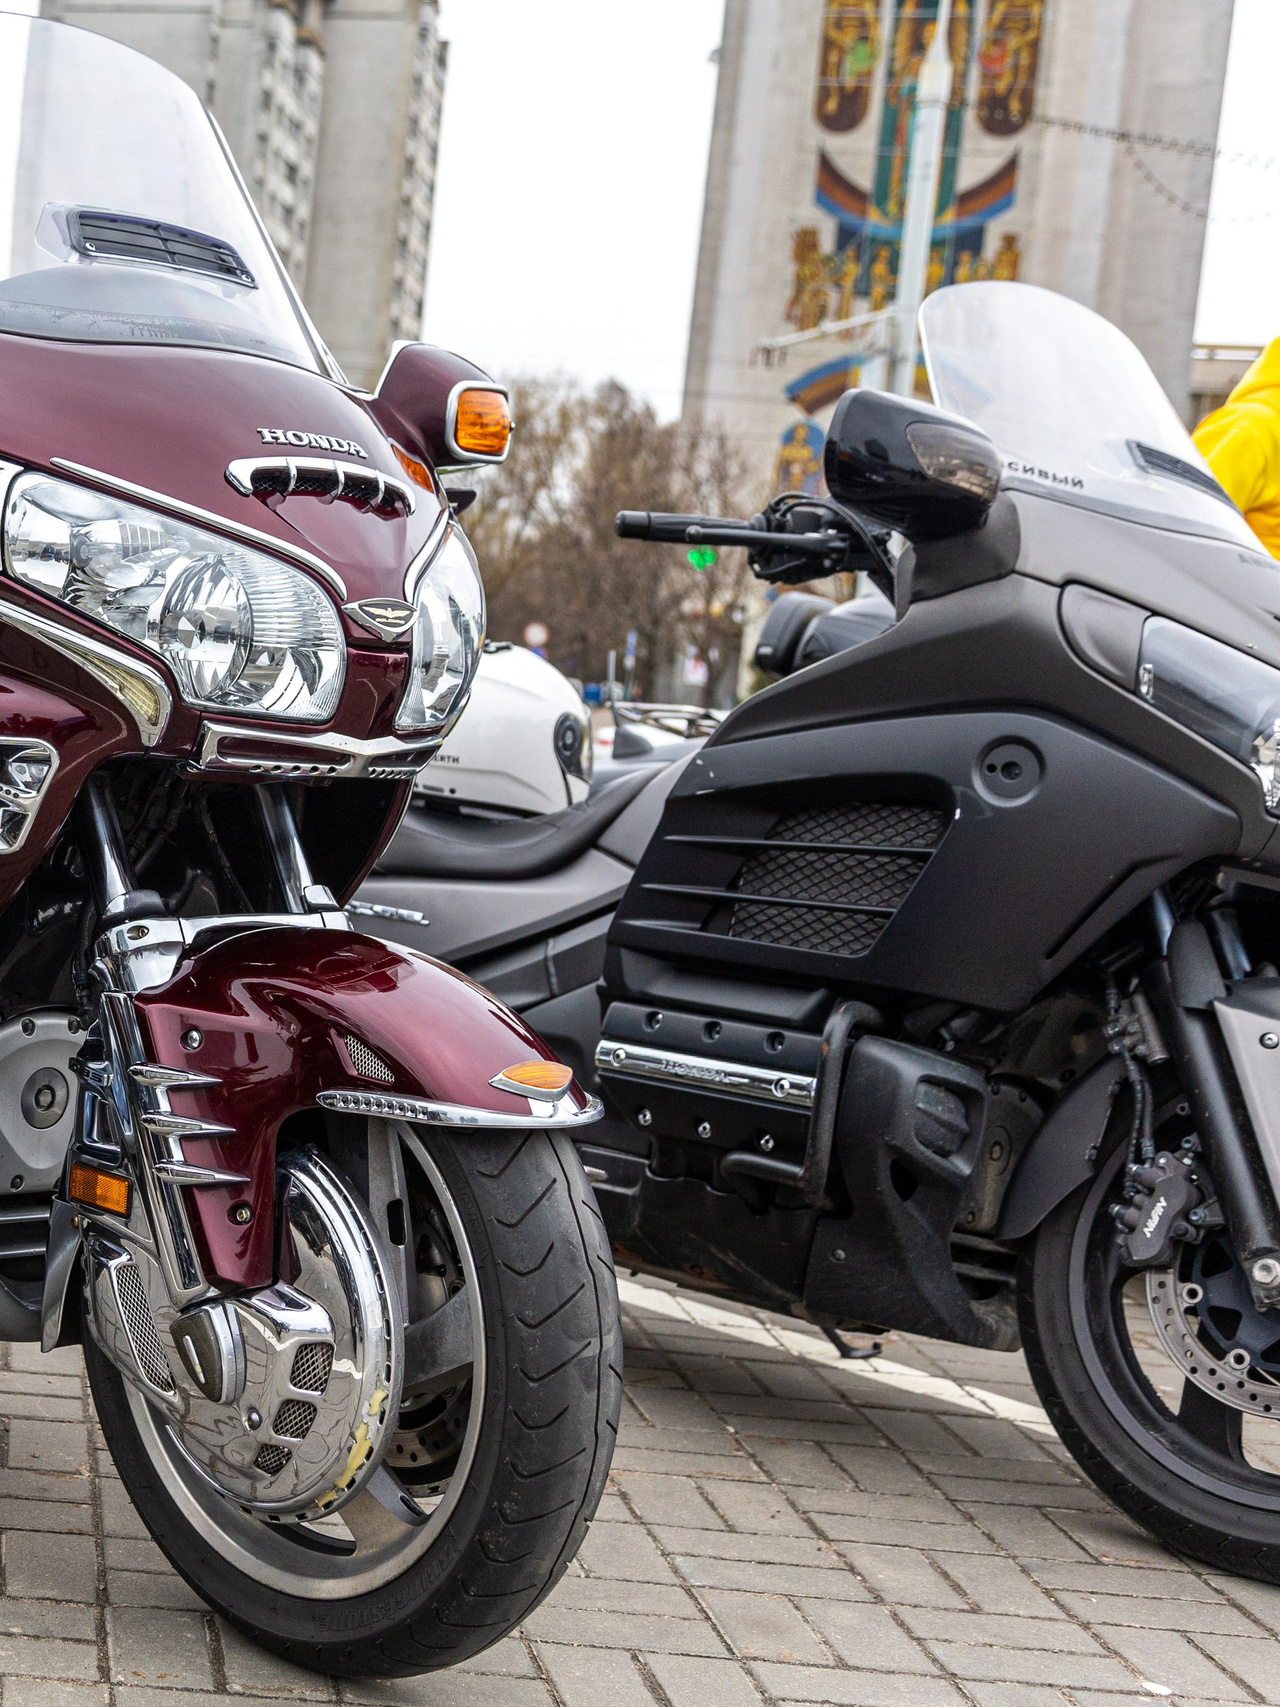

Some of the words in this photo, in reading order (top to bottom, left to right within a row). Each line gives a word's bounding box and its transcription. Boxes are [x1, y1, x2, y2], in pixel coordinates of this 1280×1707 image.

[256, 427, 369, 459] HONDA
[1001, 460, 1085, 489] СИВЫЙ
[434, 753, 460, 765] ERTH
